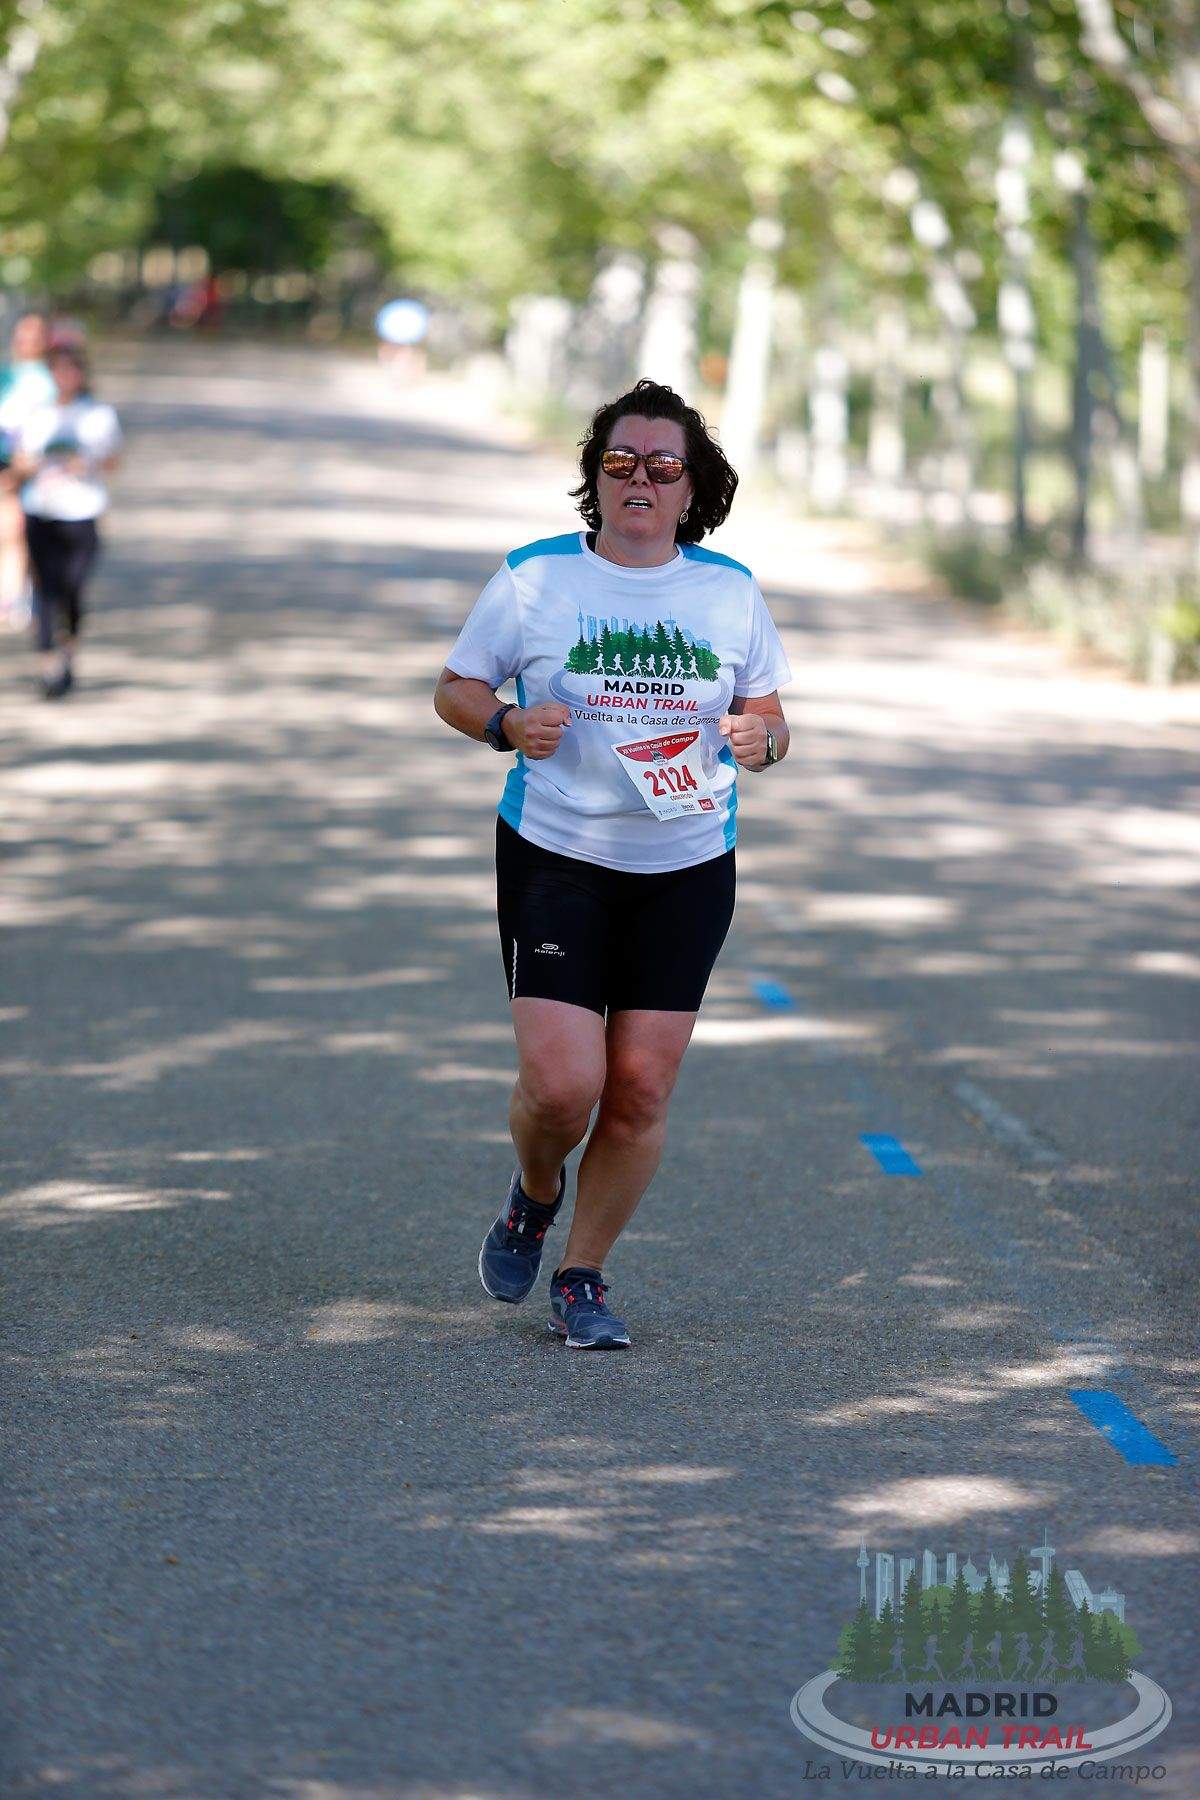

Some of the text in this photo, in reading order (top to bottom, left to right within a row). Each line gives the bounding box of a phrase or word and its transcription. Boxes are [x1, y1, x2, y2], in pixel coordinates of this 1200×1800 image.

[604, 680, 685, 695] MADRID
[587, 695, 699, 711] URBAN TRAIL
[574, 710, 613, 722] Vuelta
[627, 714, 638, 724] la
[641, 715, 668, 725] Casa
[671, 716, 685, 725] de
[671, 736, 694, 745] Campo
[643, 765, 698, 796] 2124
